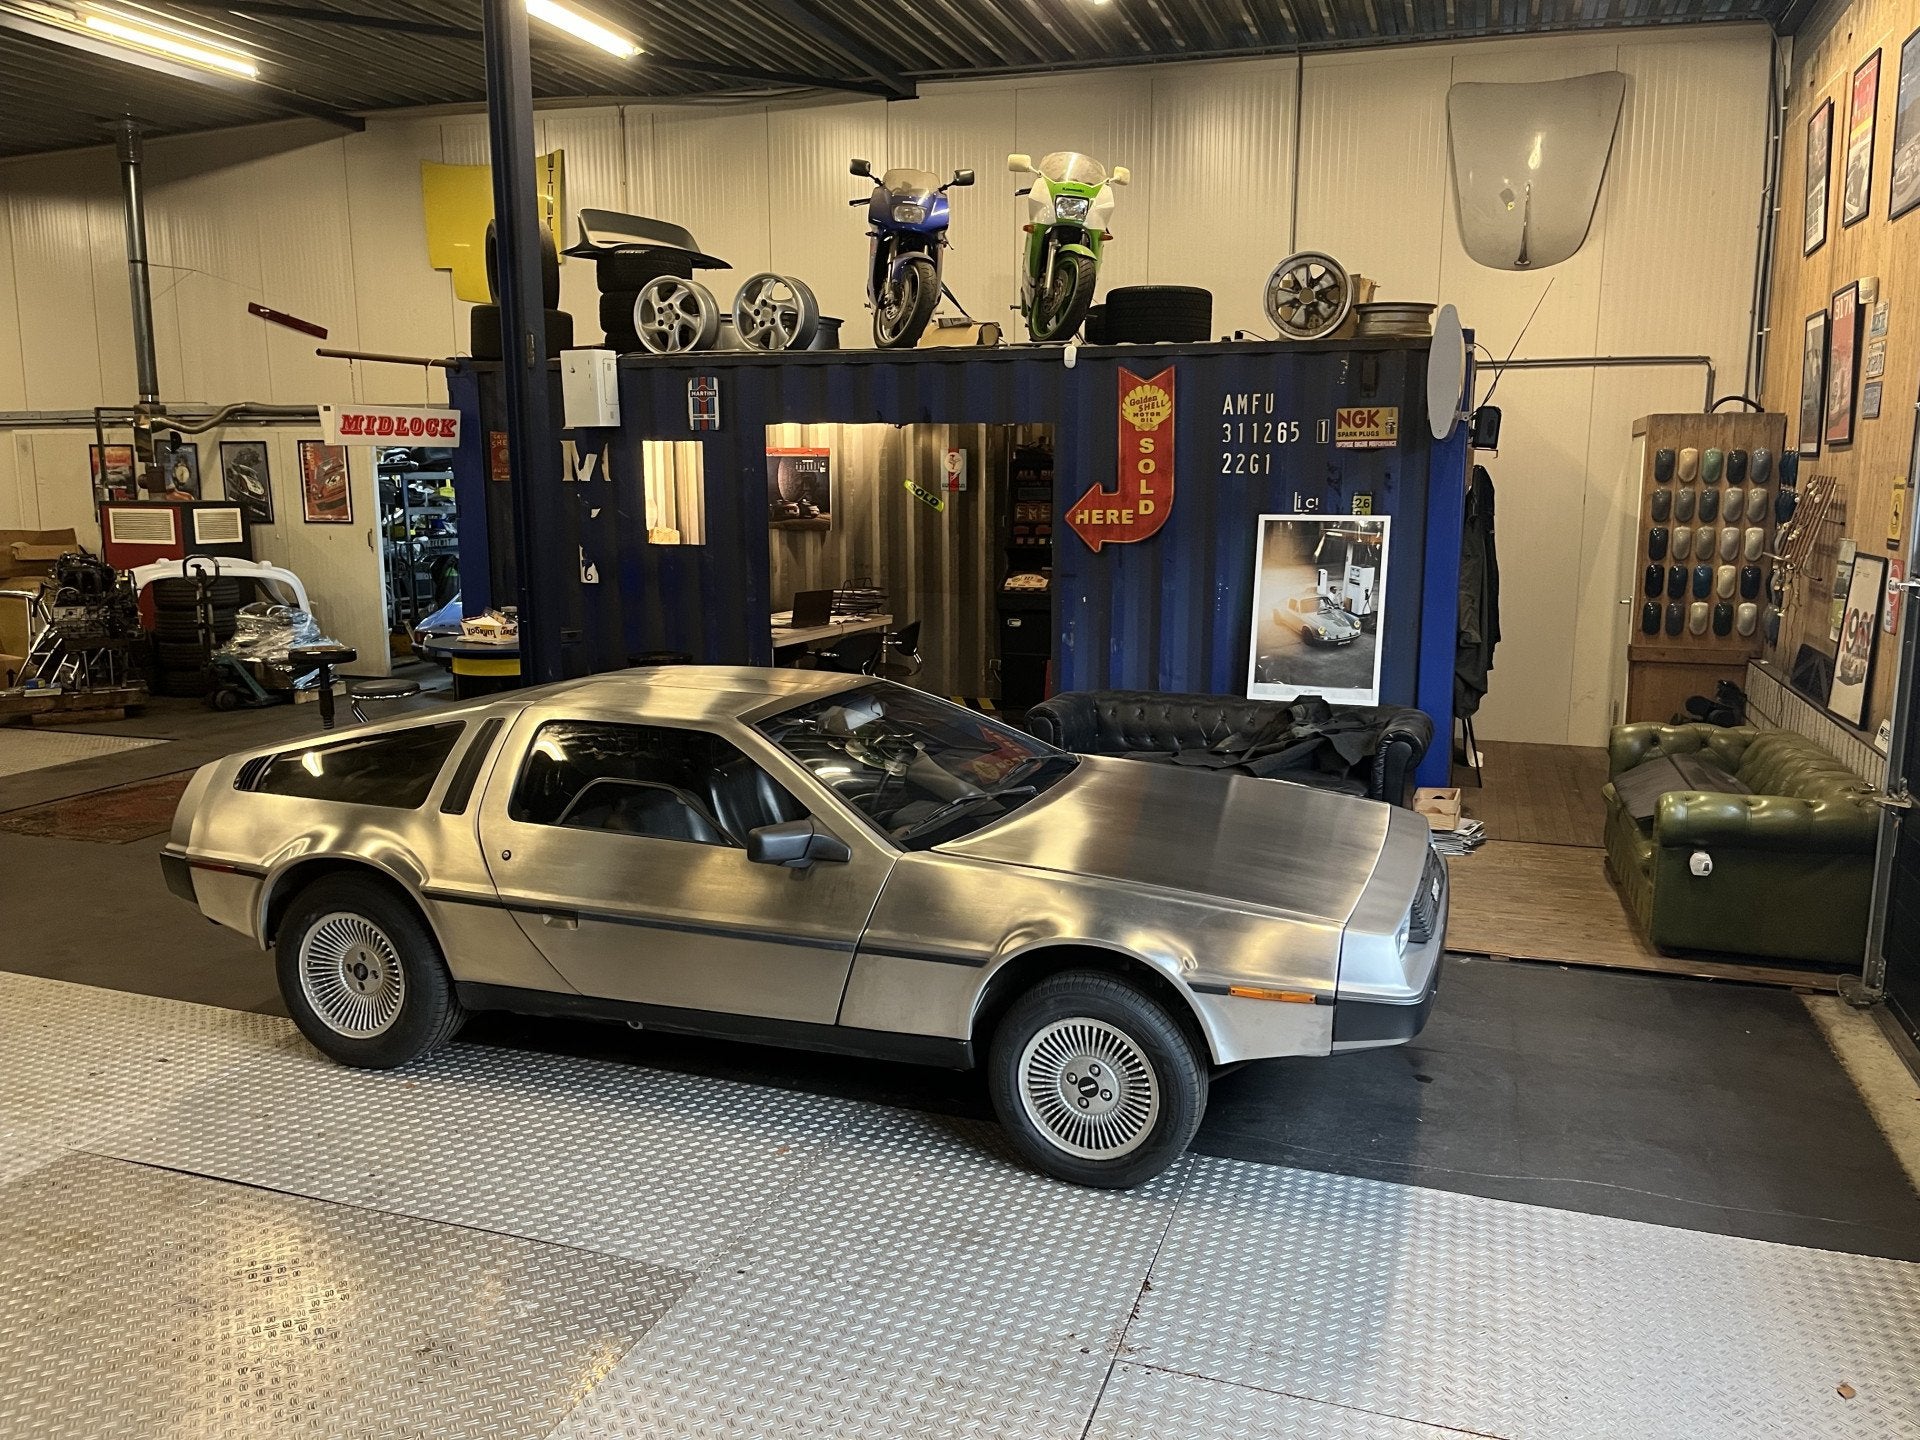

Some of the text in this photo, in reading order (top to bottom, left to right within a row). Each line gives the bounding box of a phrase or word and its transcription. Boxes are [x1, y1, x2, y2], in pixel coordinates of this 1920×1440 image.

[1129, 395, 1158, 406] Golden
[1138, 400, 1166, 412] SHELL
[1222, 392, 1275, 415] AMFU
[340, 414, 457, 438] MIDLOCK
[1337, 409, 1380, 430] NGK
[1222, 421, 1300, 444] 311265
[1221, 452, 1271, 475] 22G1
[1137, 437, 1156, 515] SOLD
[909, 482, 940, 508] SOLD
[1075, 509, 1134, 525] HERE
